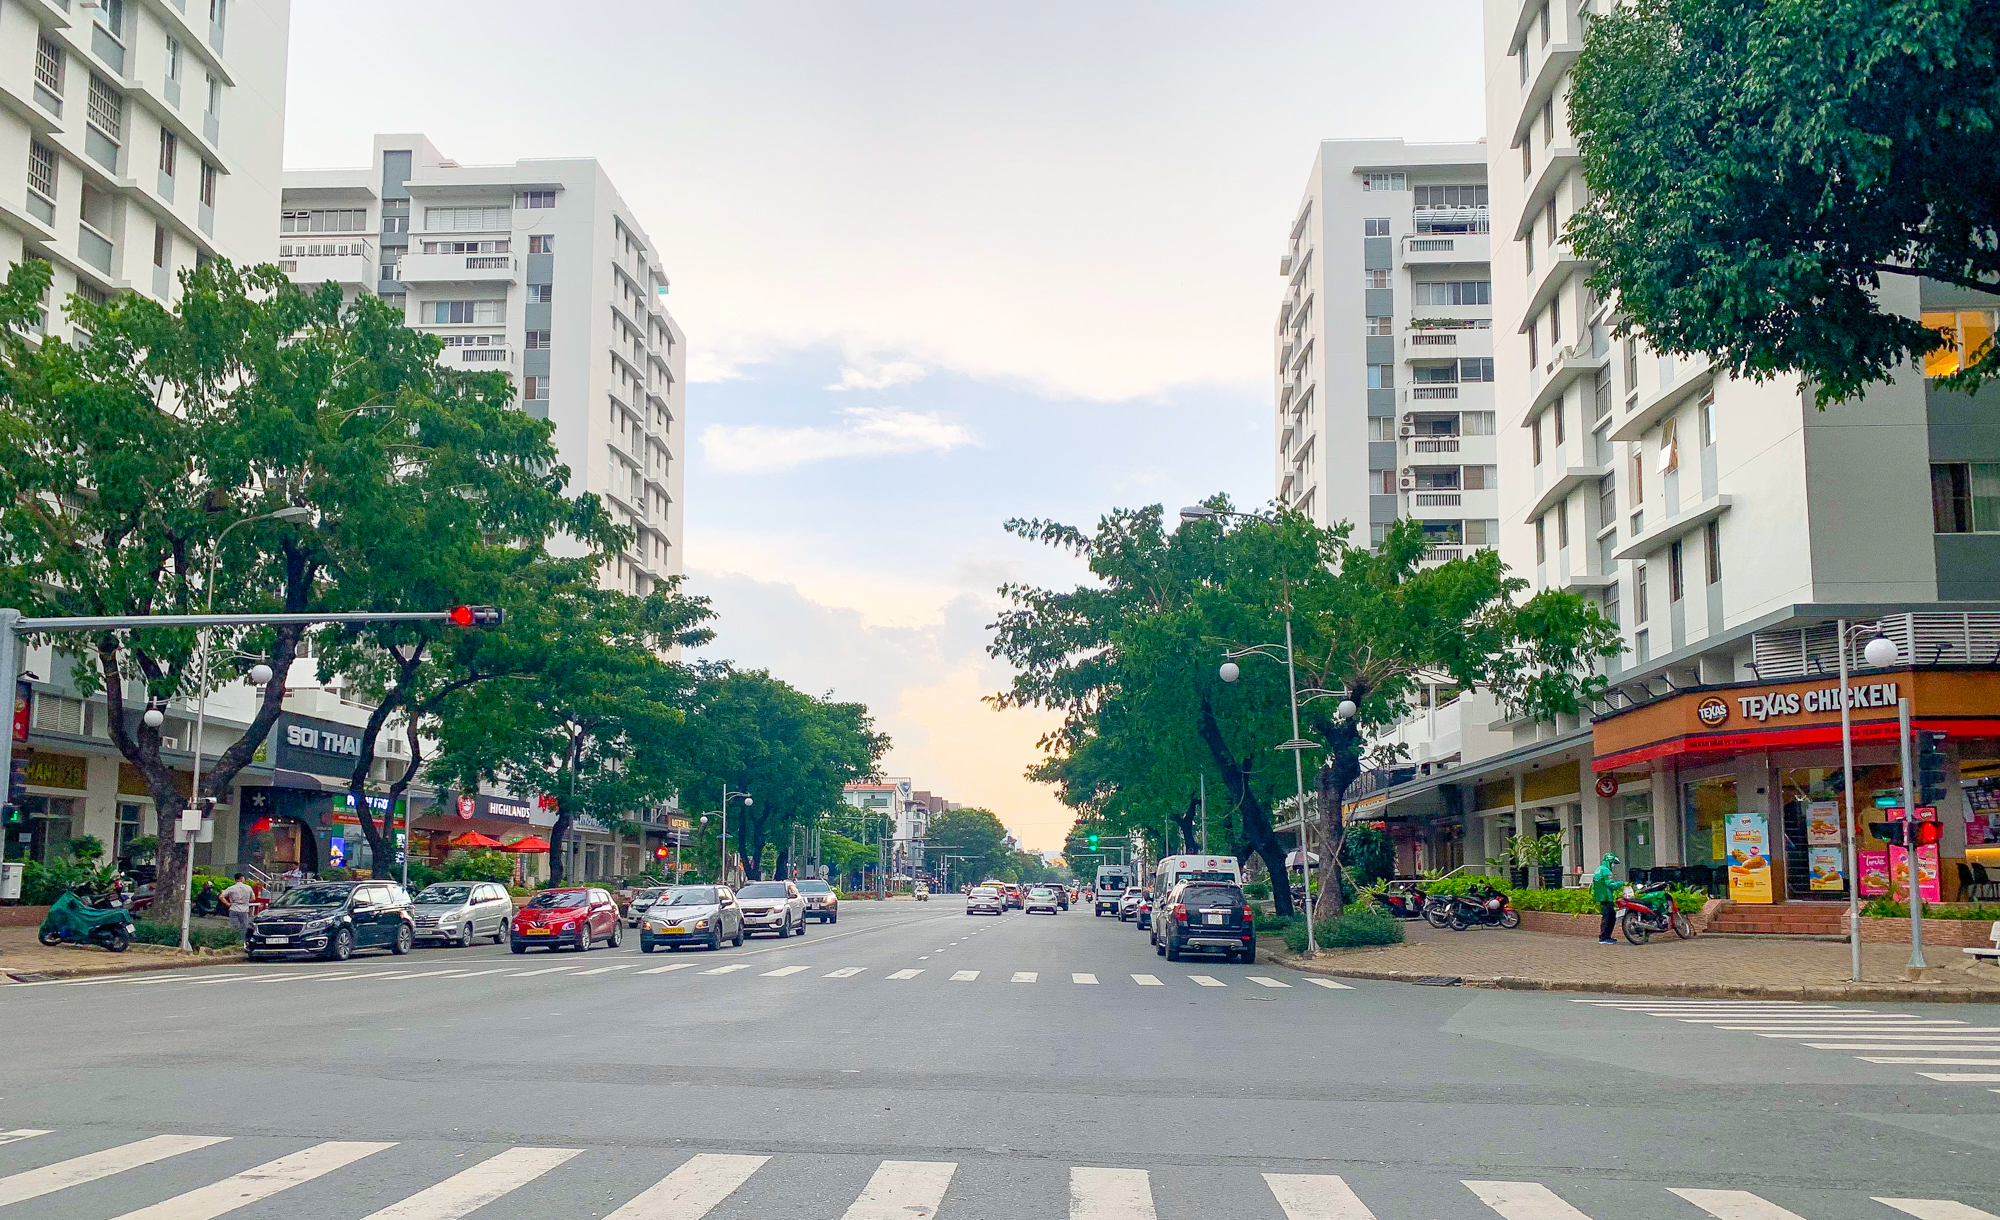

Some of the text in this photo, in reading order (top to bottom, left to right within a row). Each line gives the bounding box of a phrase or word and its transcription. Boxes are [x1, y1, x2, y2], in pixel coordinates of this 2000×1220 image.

[1699, 705, 1727, 719] TEXAS
[1738, 693, 1800, 721] TEXAS
[287, 725, 360, 756] SOI THAI
[490, 802, 530, 818] HIGHLANDS
